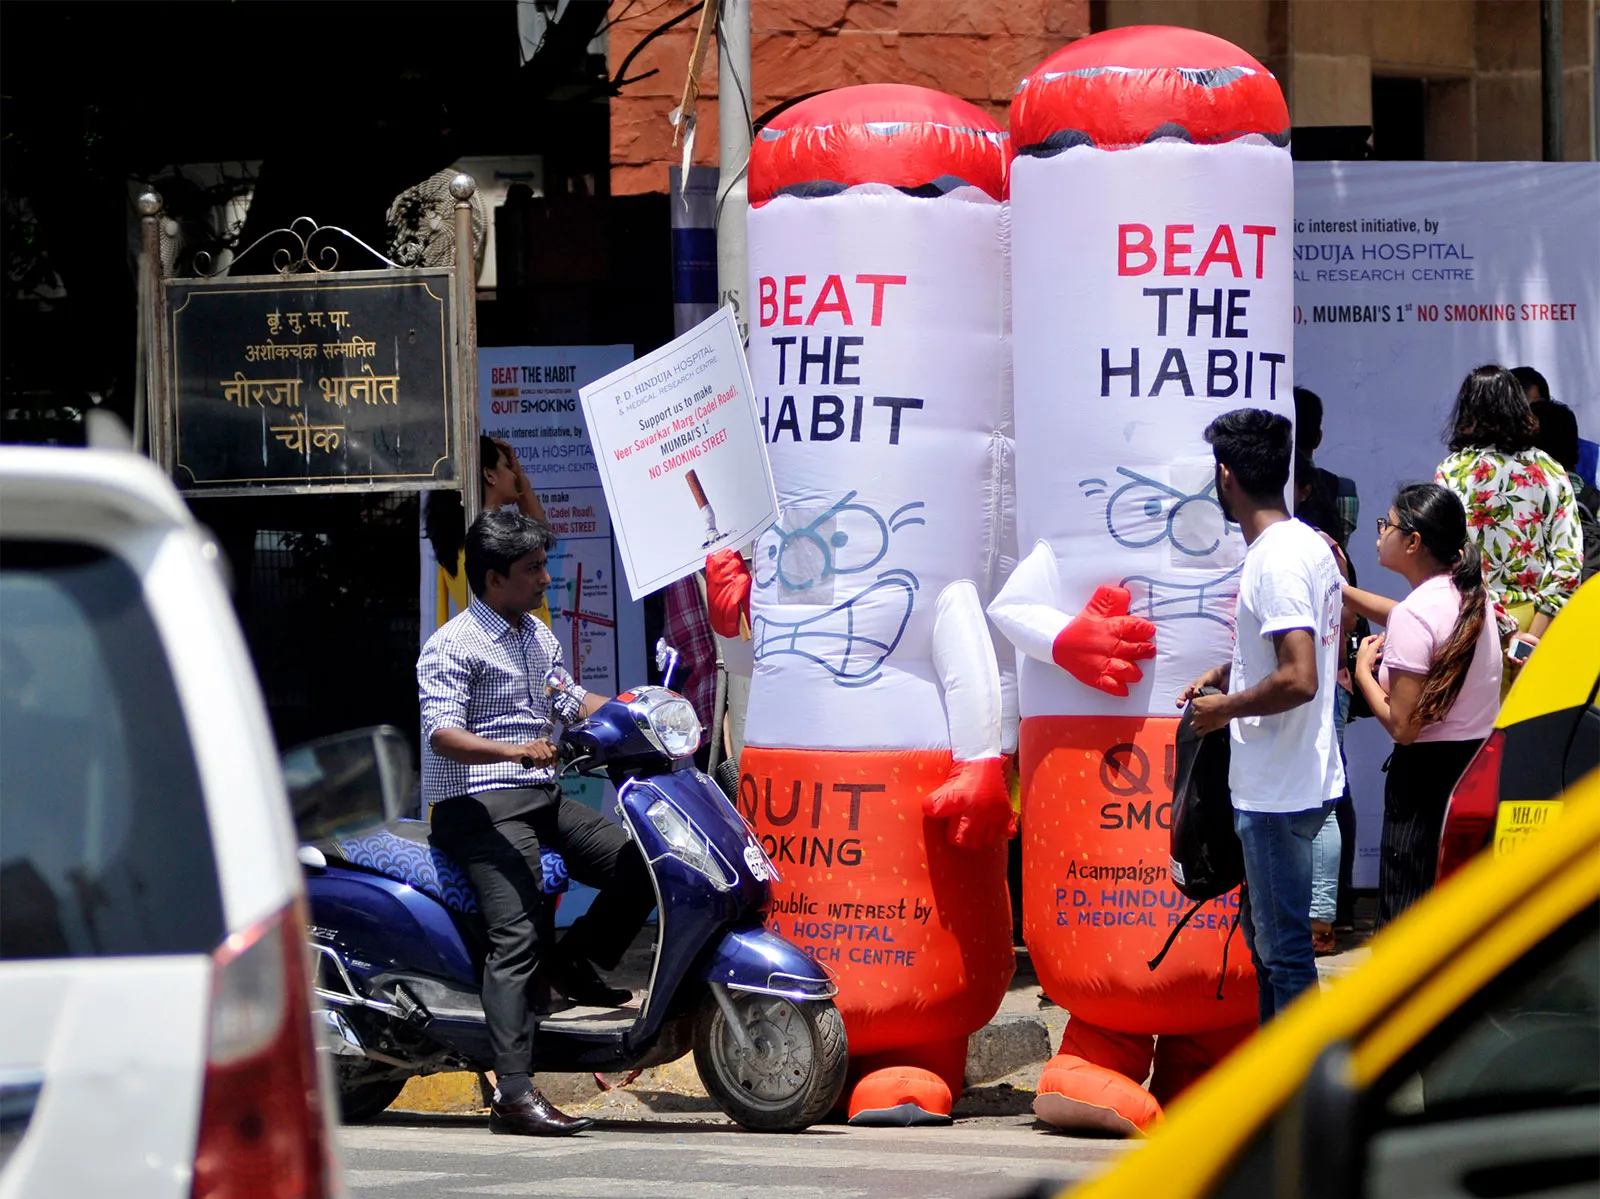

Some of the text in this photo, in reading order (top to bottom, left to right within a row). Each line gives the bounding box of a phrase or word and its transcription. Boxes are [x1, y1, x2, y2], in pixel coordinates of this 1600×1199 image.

[1308, 219, 1358, 233] interest
[1361, 218, 1421, 234] initiative,
[1424, 219, 1439, 235] by
[1118, 223, 1276, 279] BEAT
[1293, 243, 1474, 264] NDUJA HOSPITAL
[1317, 269, 1405, 282] RESEARCH
[1411, 268, 1475, 281] CENTRE
[759, 274, 907, 327] BEAT
[1142, 287, 1250, 338] THE
[1312, 305, 1391, 323] MUMBAI'S
[1417, 305, 1439, 322] NO
[1444, 304, 1515, 322] SMOKING
[1520, 303, 1577, 321] STREET
[491, 365, 576, 384] BEAT THE HABIT
[635, 372, 673, 396] HINDUJA
[674, 345, 716, 374] HOSPITAL
[771, 336, 864, 385] THE
[1100, 348, 1286, 400] HABIT
[220, 364, 401, 409] नीरजा भानोत
[626, 394, 658, 412] MEDICAL
[659, 372, 695, 396] RESEARCH
[696, 356, 719, 374] CENTRE
[491, 399, 576, 415] QUIT SMOKING
[614, 384, 739, 461] Veer Savarkar Marg (Cadel Road),
[639, 383, 713, 431] Support us to make
[270, 413, 345, 455] चौक
[512, 427, 538, 438] interest
[574, 426, 583, 439] by
[660, 426, 701, 456] MUMBAI'S
[514, 444, 593, 461] DUJA HOSPITA
[648, 428, 729, 480] NO SMOKING STREET
[542, 493, 550, 503] to
[551, 492, 569, 503] make
[571, 521, 596, 533] STREET
[740, 773, 886, 831] QUIT
[757, 834, 862, 867] OKING
[771, 893, 818, 918] public
[913, 898, 932, 925] by
[1056, 912, 1069, 926] &
[1078, 911, 1156, 927] MEDICAL
[794, 922, 895, 943] HOSPITAL
[849, 948, 917, 966] CENTRE
